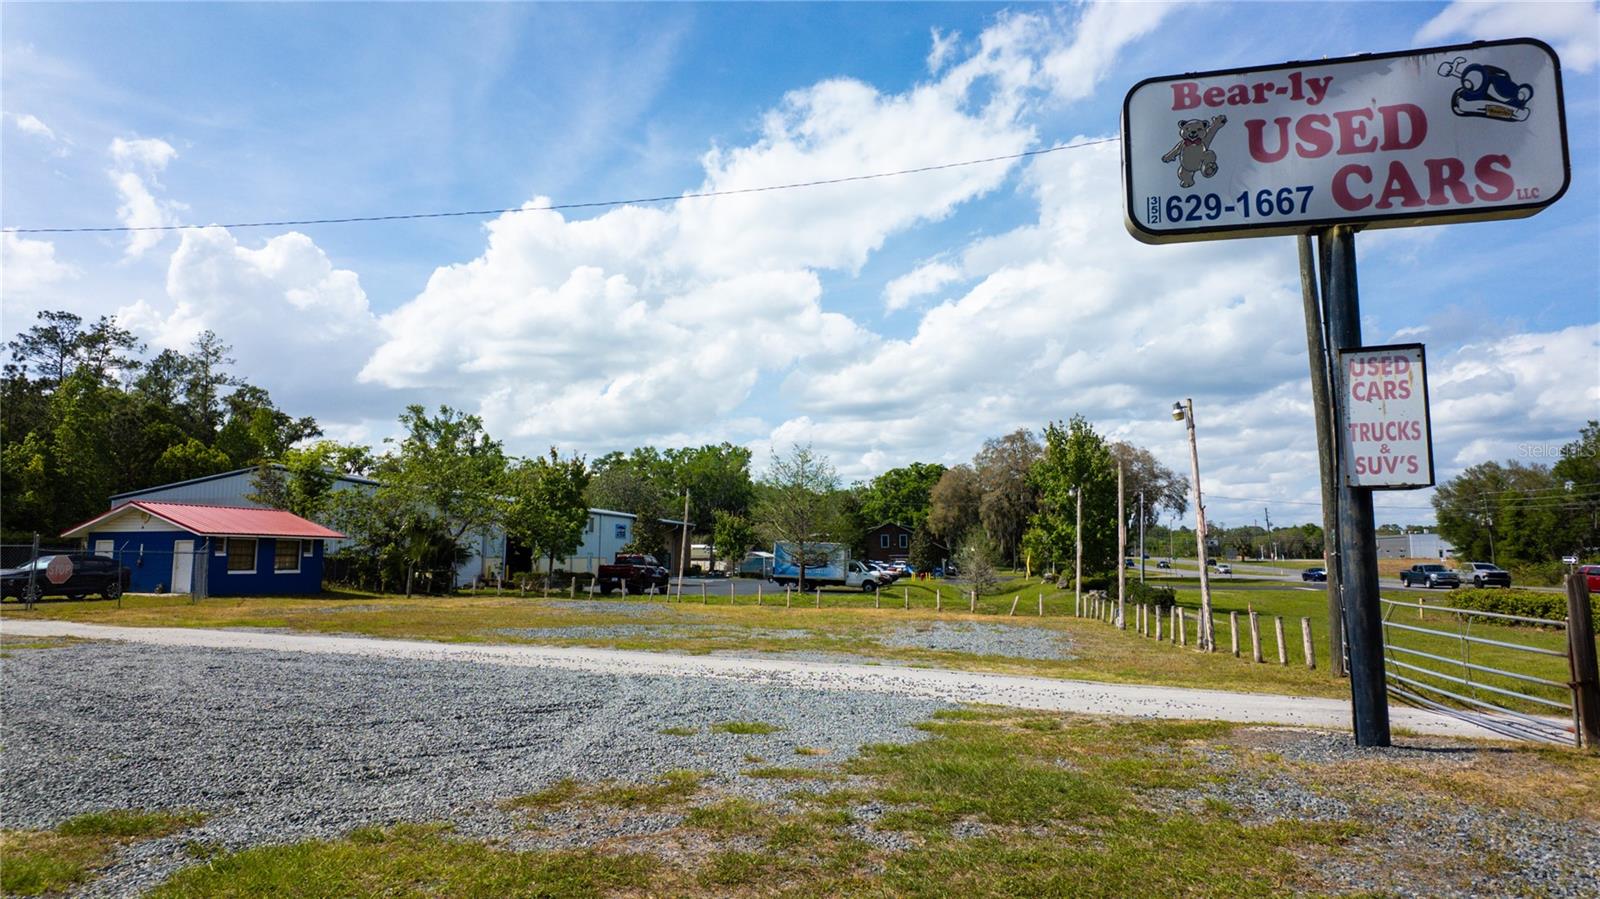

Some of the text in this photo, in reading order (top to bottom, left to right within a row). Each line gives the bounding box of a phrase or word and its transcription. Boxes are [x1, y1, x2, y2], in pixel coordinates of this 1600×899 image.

[1171, 72, 1334, 111] Bear-ly
[1245, 103, 1428, 163] USED
[1331, 154, 1540, 211] CARS LLC
[1165, 185, 1314, 223] 629-1667
[1349, 355, 1411, 377] USED
[1352, 380, 1411, 401] CARS
[1349, 421, 1421, 441] TRUCKS
[1380, 444, 1390, 454] &
[1356, 456, 1418, 474] SUV'S
